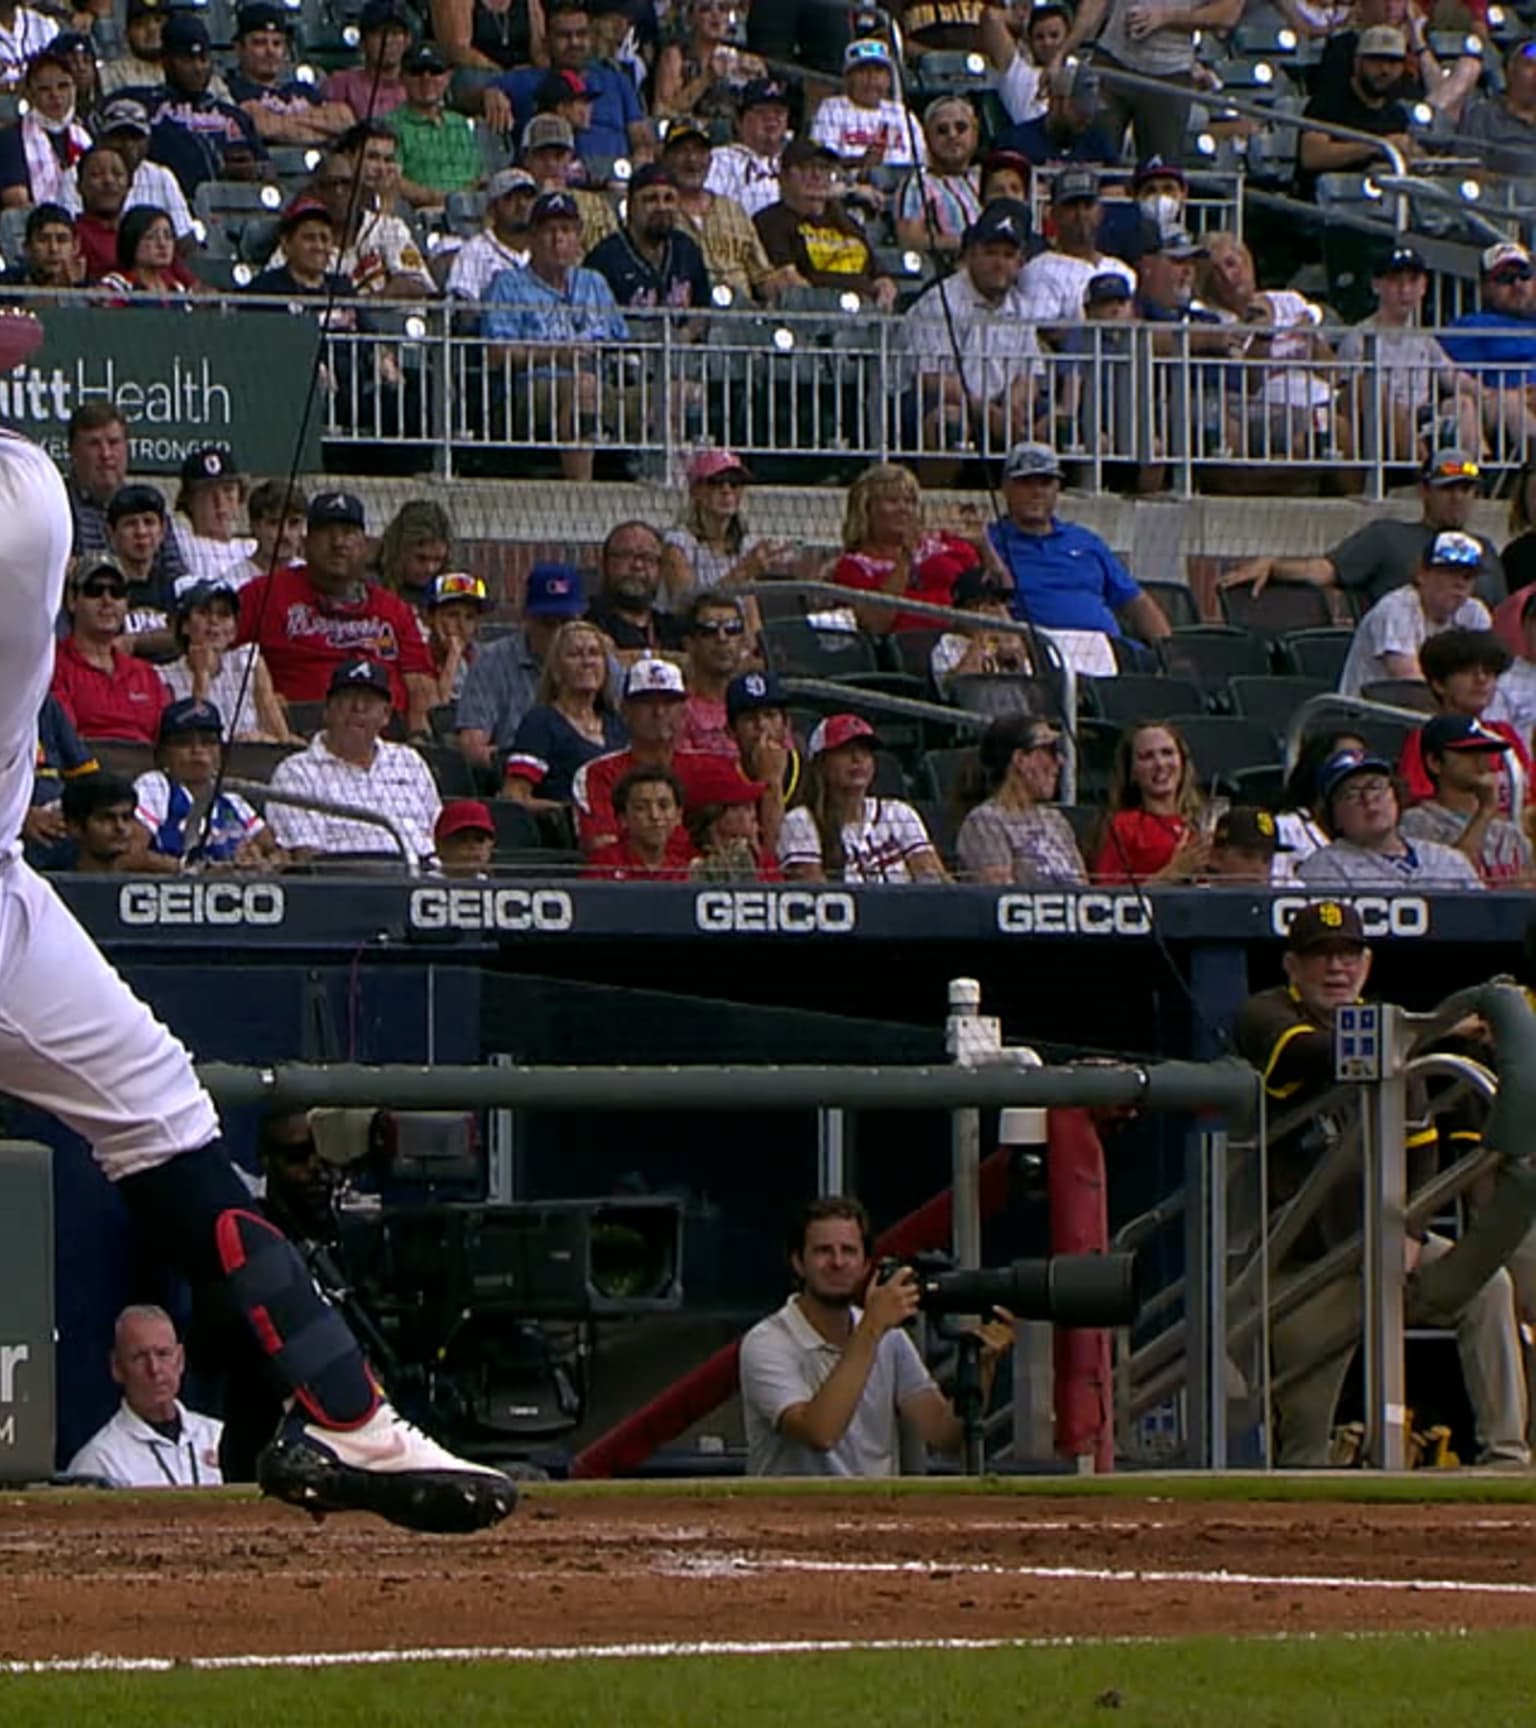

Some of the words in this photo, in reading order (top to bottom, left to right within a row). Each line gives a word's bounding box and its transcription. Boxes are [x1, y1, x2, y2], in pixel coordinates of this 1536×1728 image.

[119, 883, 285, 925] GEICO
[409, 889, 573, 931] GEICO
[696, 891, 856, 932] GEICO
[996, 893, 1153, 934] GEICO
[1273, 897, 1429, 937] GCO
